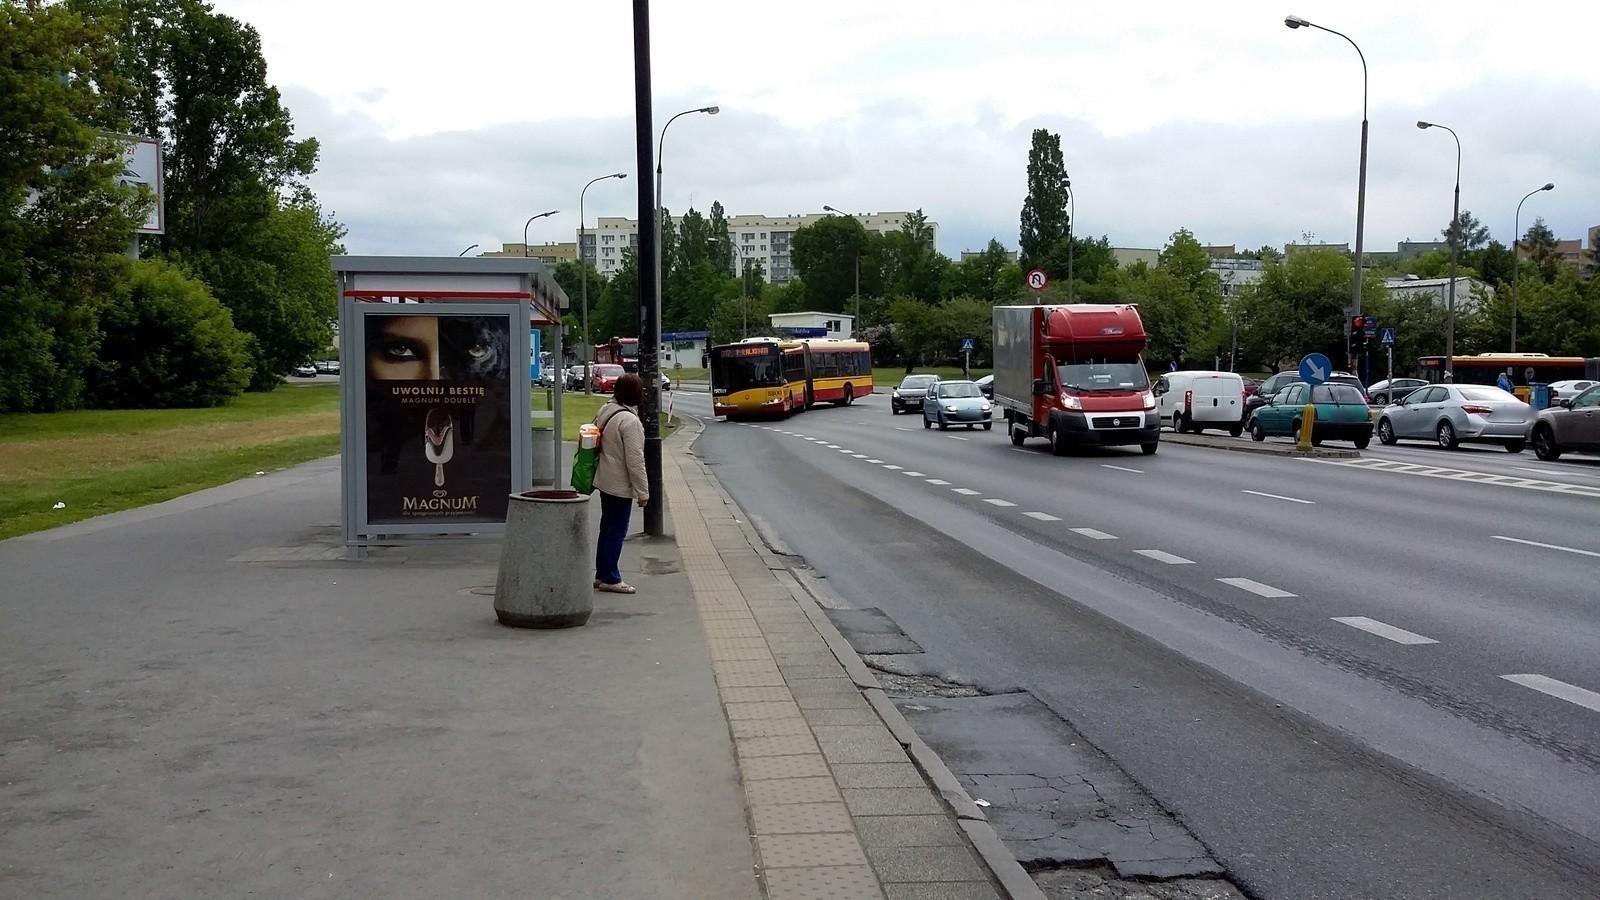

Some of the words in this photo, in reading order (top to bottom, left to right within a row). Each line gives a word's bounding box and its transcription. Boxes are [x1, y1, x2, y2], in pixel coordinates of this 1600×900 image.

[392, 387, 444, 395] UWOLNIJ
[449, 387, 485, 397] BESTIĘ
[403, 496, 477, 509] MAGNUM
